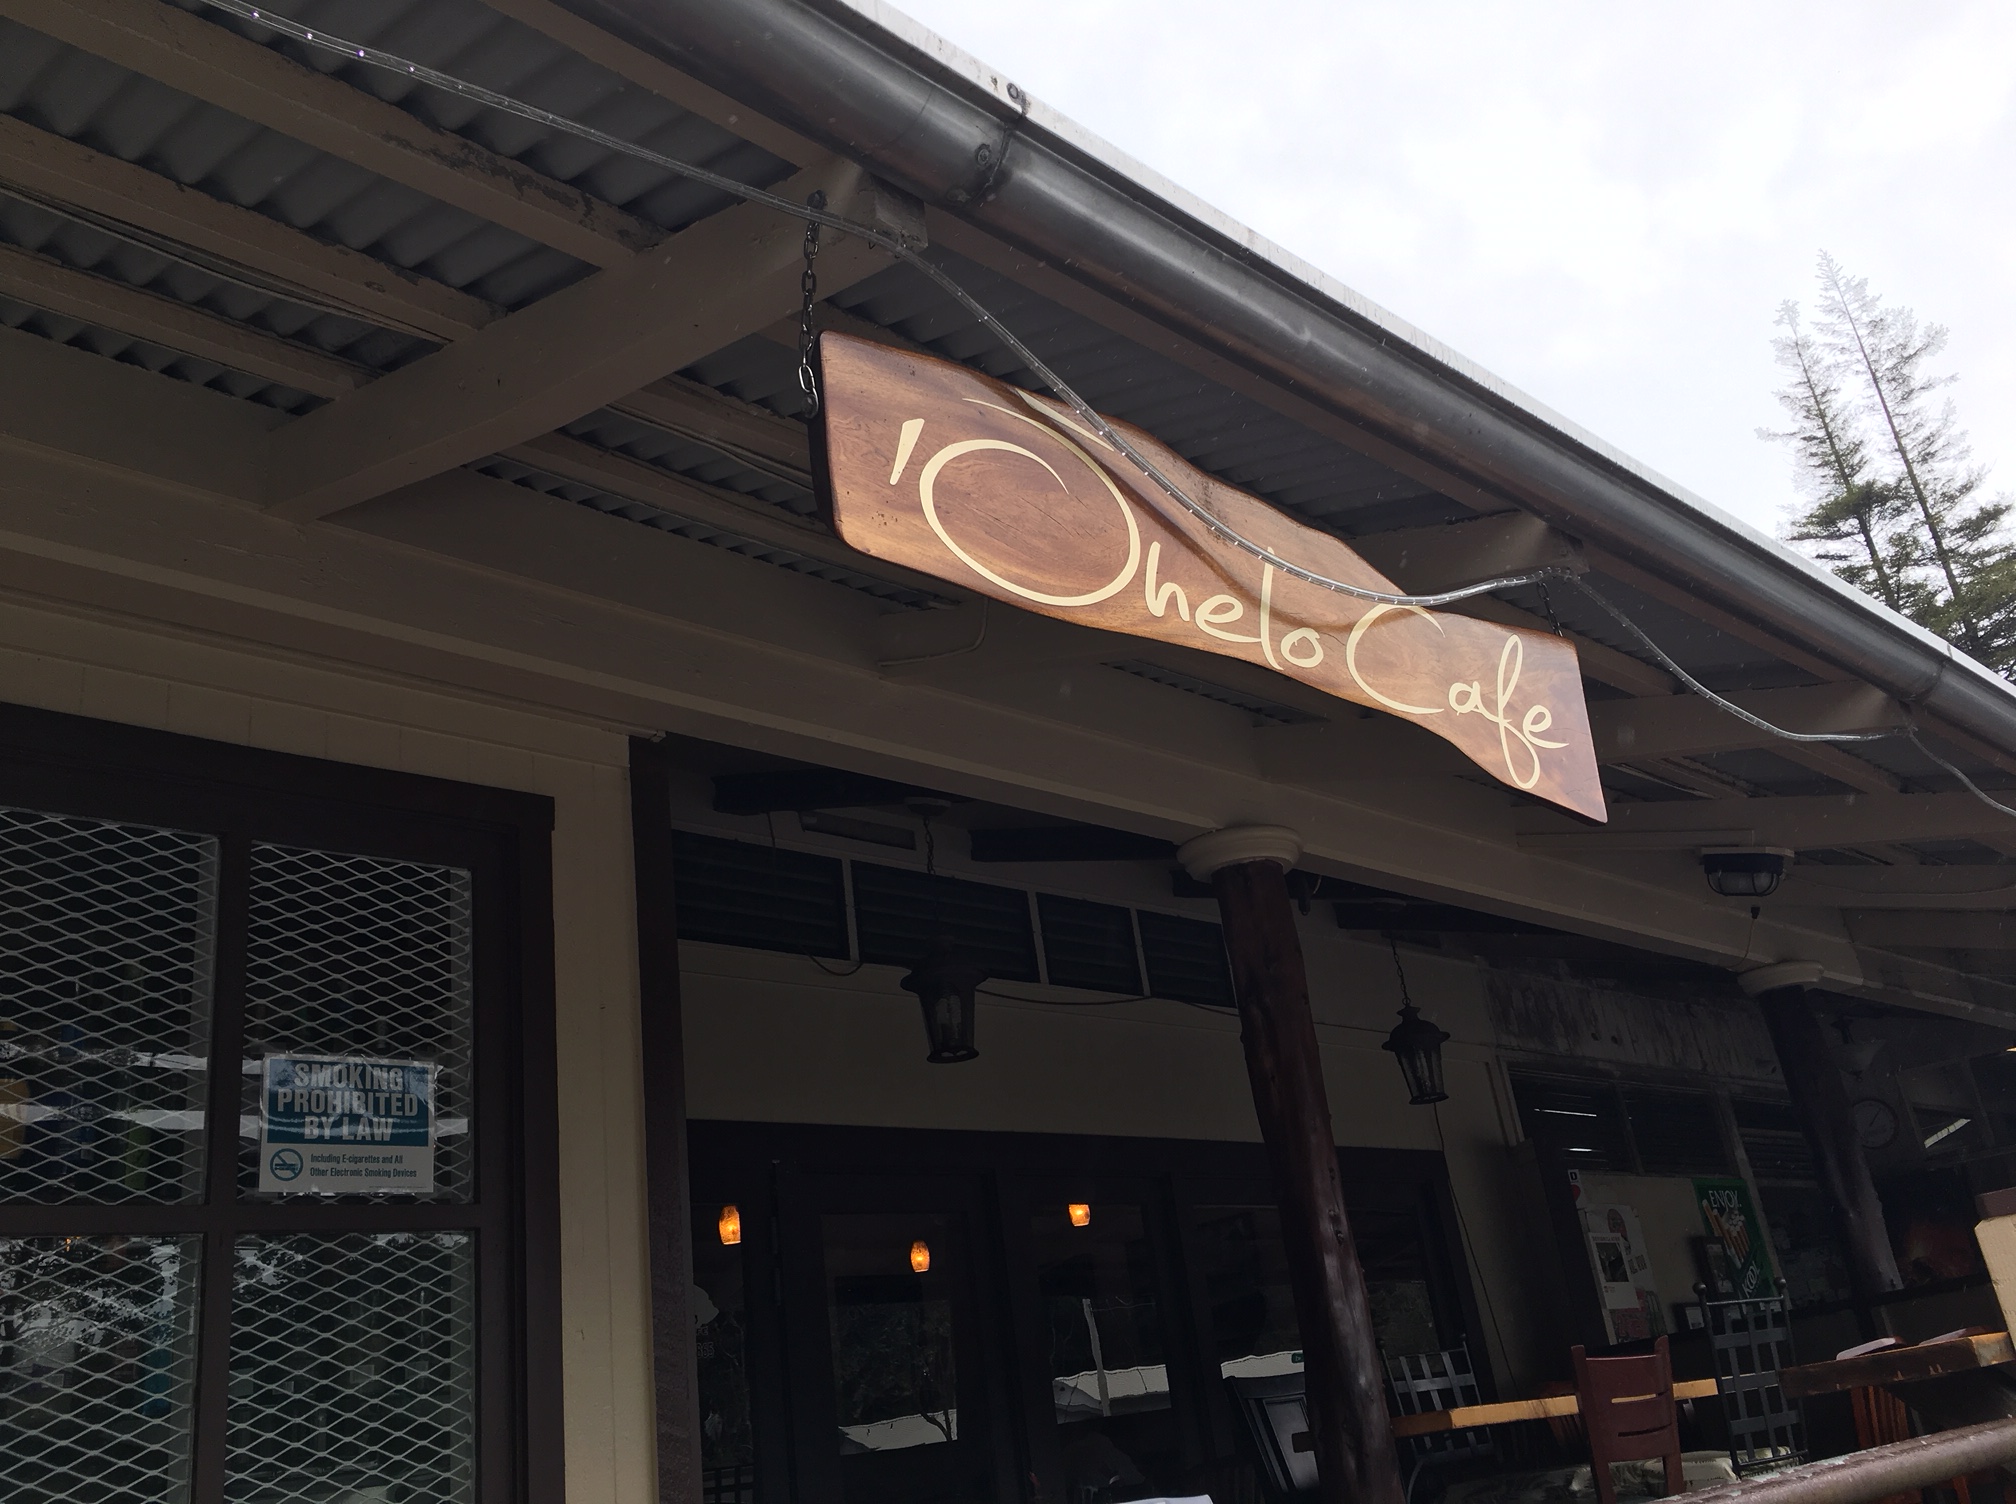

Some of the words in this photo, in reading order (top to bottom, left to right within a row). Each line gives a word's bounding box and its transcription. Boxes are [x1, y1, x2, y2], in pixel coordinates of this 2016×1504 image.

[1346, 602, 1569, 789] Cafe
[294, 1063, 404, 1091] SMOKING
[277, 1088, 419, 1117] PROHIBITED
[303, 1115, 335, 1140] BY
[341, 1116, 394, 1142] LAW
[310, 1153, 341, 1164] Including
[342, 1154, 380, 1164] E-cigarettes
[381, 1155, 393, 1164] and
[394, 1155, 404, 1164] All
[310, 1167, 329, 1177] Other
[330, 1168, 363, 1177] Electronic
[364, 1168, 392, 1178] Smoking
[393, 1168, 417, 1178] Devices
